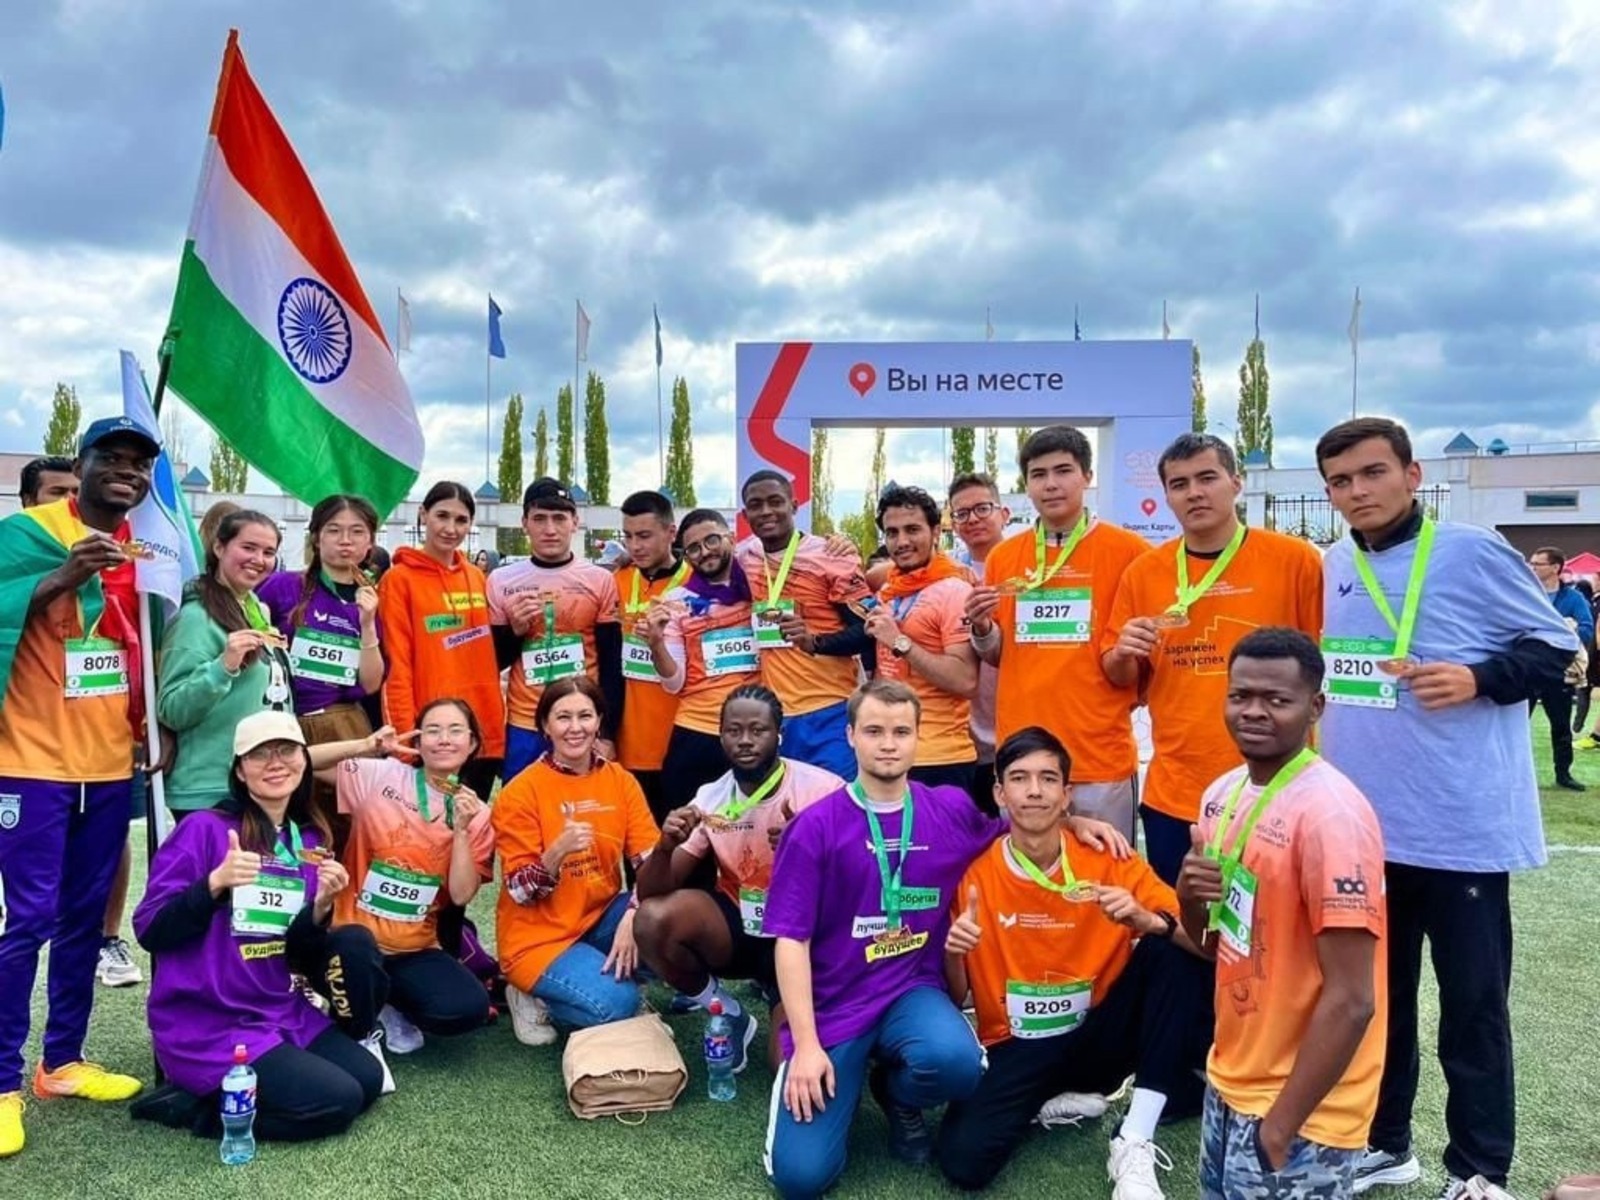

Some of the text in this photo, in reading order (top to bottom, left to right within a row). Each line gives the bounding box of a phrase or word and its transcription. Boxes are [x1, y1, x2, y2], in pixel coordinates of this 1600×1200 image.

[887, 368, 1063, 391] Вы на месте
[1033, 605, 1071, 618] 8217
[308, 645, 343, 662] 6361
[630, 648, 653, 661] 821
[715, 640, 751, 655] 3606
[83, 655, 119, 671] 8078
[534, 650, 569, 665] 6364
[1333, 659, 1373, 676] 8210
[259, 891, 283, 907] 312
[379, 882, 420, 901] 6358
[874, 936, 923, 955] будущее
[1024, 999, 1072, 1015] 8209
